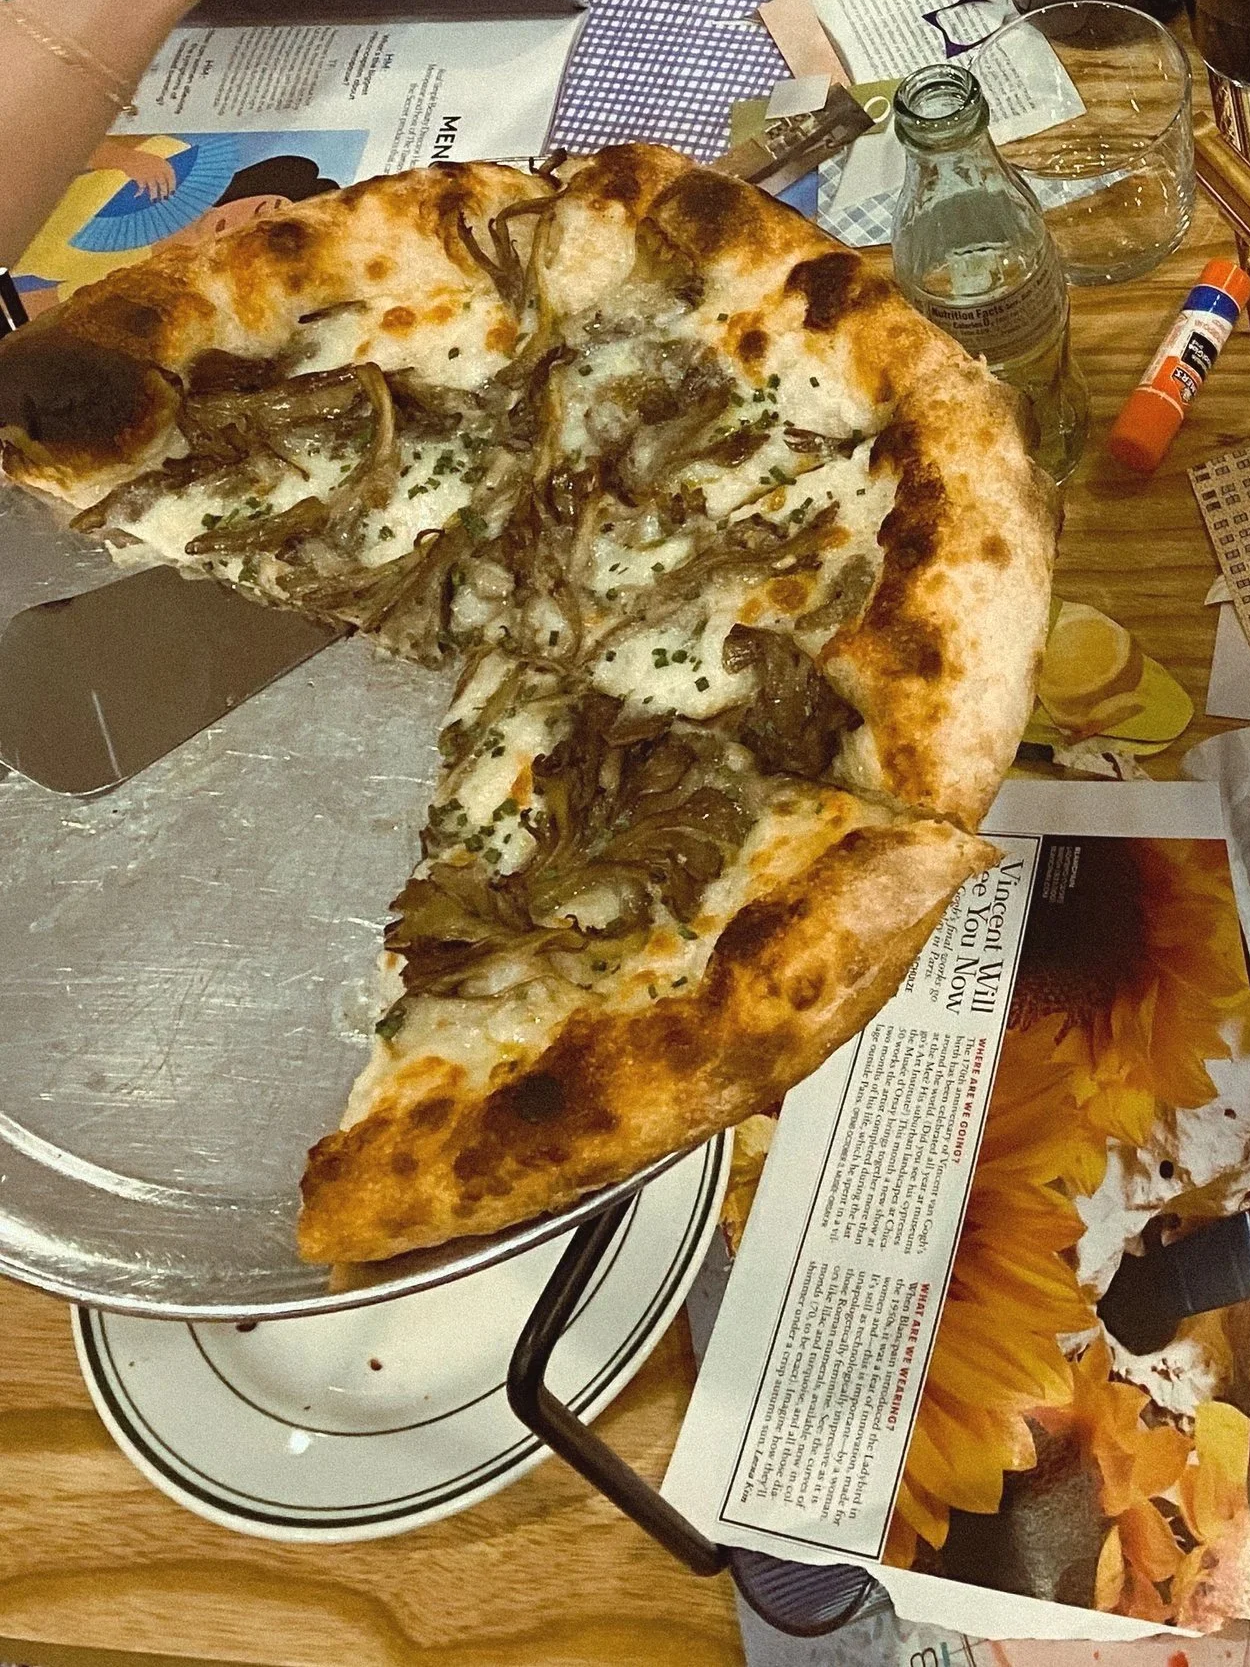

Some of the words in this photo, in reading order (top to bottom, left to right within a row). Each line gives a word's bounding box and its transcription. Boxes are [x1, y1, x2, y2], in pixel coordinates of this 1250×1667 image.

[931, 306, 974, 321] Nutrition
[975, 304, 1004, 319] Facts
[971, 868, 990, 897] ee
[982, 861, 1024, 951] Vincent
[942, 921, 958, 952] final
[960, 902, 992, 947] You
[931, 935, 941, 948] in
[924, 950, 940, 979] Paris.
[933, 952, 948, 987] works
[928, 987, 939, 1003] go
[945, 955, 980, 1015] Now
[970, 958, 1004, 1013] Will
[917, 1029, 928, 1049] go's
[931, 1031, 940, 1041] at
[951, 1034, 966, 1059] birth
[963, 1037, 976, 1056] The
[913, 1050, 926, 1067] Art
[927, 1042, 939, 1059] the
[937, 1033, 951, 1068] around
[971, 1037, 987, 1074] WHERE
[921, 1060, 935, 1084] Met?
[932, 1069, 944, 1086] the
[946, 1060, 960, 1077] has
[957, 1058, 970, 1085] 170th
[916, 1085, 929, 1102] His
[940, 1078, 955, 1103] been
[965, 1076, 978, 1098] ARE
[925, 1087, 938, 1117] world.
[941, 1086, 962, 1142] anniversary
[961, 1101, 973, 1117] WE
[894, 1118, 909, 1139] This
[904, 1104, 922, 1150] suburban
[928, 1104, 946, 1155] celebrated
[913, 1144, 924, 1164] you
[940, 1143, 950, 1158] of
[951, 1120, 968, 1164] GOING?
[885, 1140, 900, 1175] month
[924, 1156, 935, 1170] all
[890, 1152, 913, 1204] landscapes
[909, 1165, 918, 1182] see
[919, 1170, 930, 1192] year
[930, 1157, 949, 1197] Vincent
[877, 1184, 889, 1207] new
[904, 1183, 917, 1198] his
[915, 1193, 924, 1205] at
[887, 1206, 896, 1217] at
[925, 1198, 936, 1216] van
[870, 1208, 885, 1236] show
[892, 1199, 909, 1246] cypresses
[903, 1205, 921, 1254] museums
[866, 1236, 875, 1248] at
[879, 1218, 895, 1251] Chica-
[914, 1282, 930, 1316] WHAT
[907, 1318, 921, 1342] ARE
[902, 1345, 914, 1363] WE
[886, 1367, 909, 1431] WEARING?
